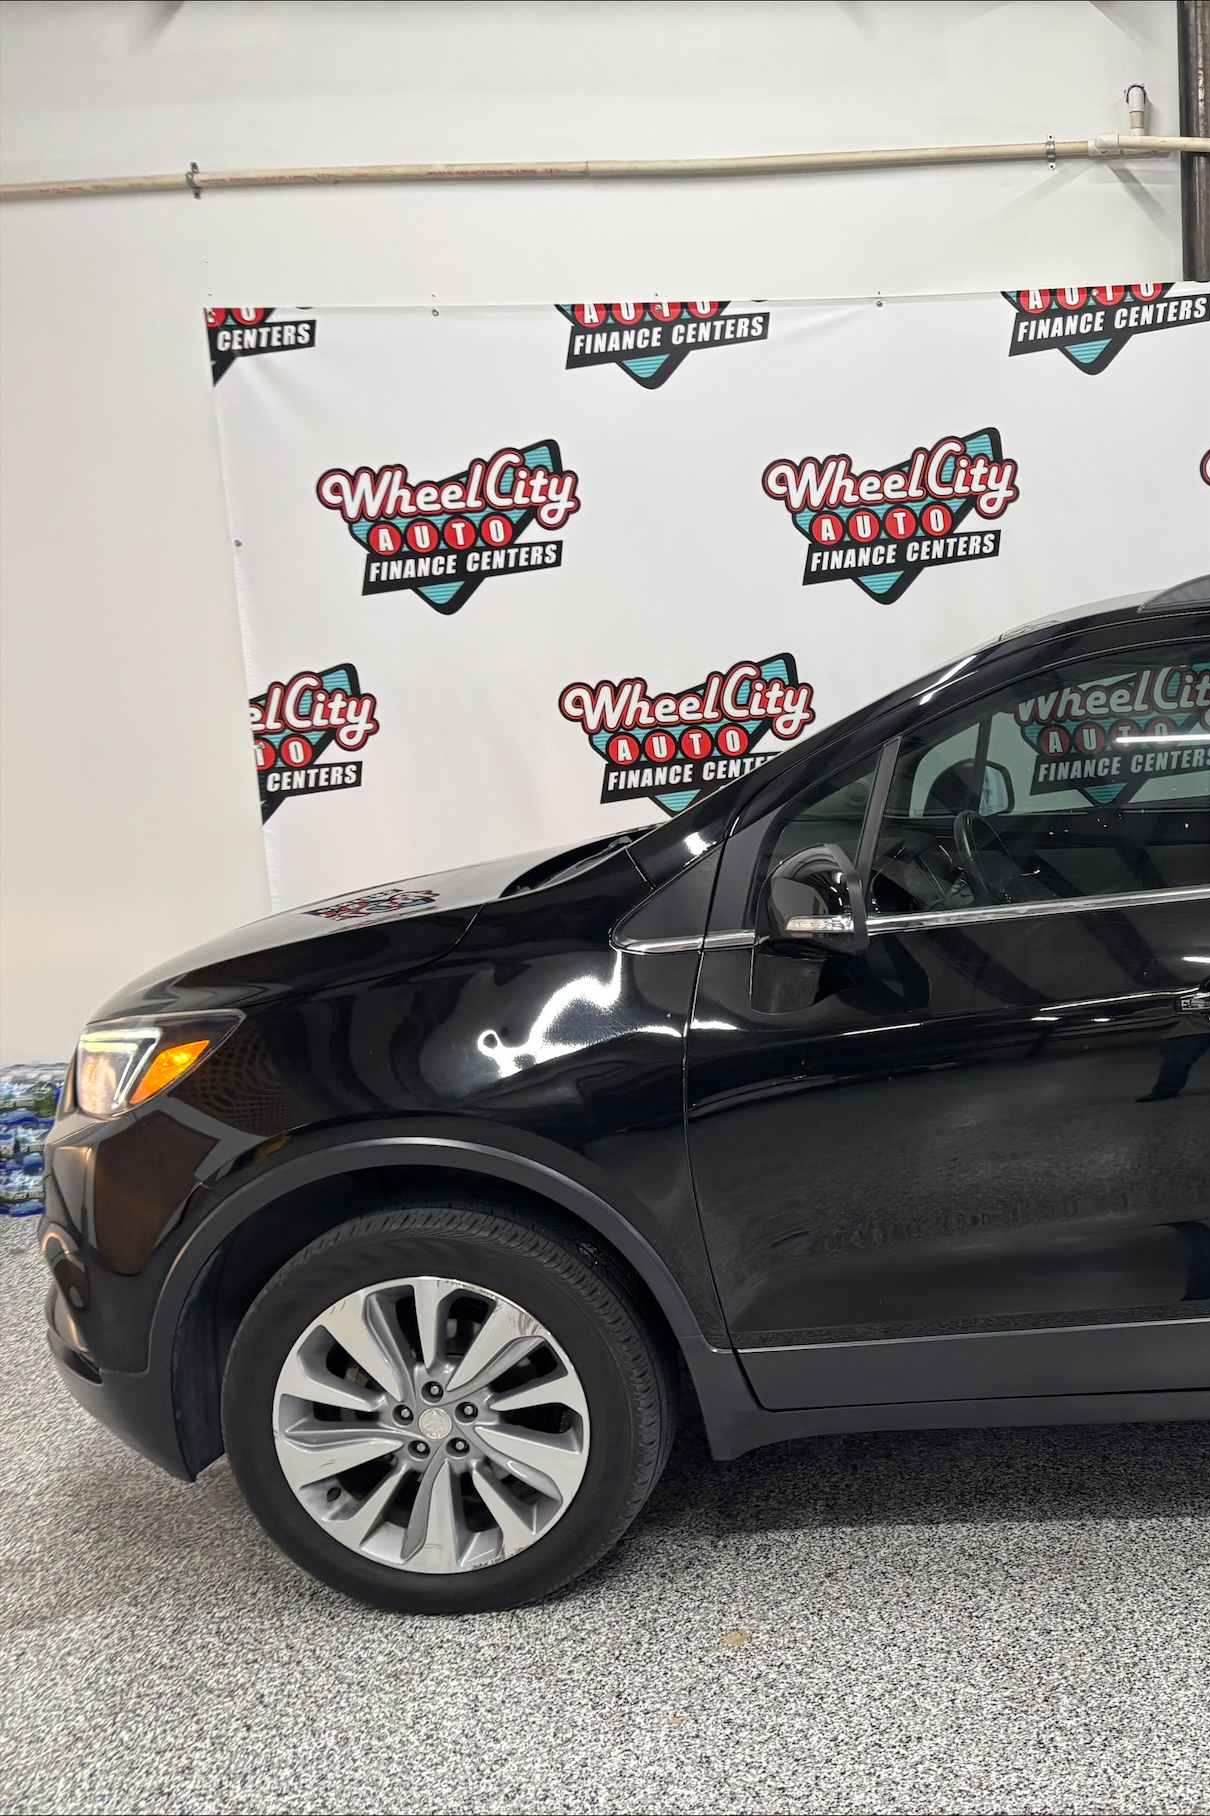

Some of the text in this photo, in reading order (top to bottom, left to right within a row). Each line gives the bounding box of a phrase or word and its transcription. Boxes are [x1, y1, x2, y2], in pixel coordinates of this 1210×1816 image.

[573, 316, 765, 356] FINANCE CENTERS
[1017, 297, 1208, 343] FINANCE CENTERS
[216, 323, 311, 352] CENTERS
[378, 519, 506, 552] AUTO
[821, 508, 945, 542] AUTO
[369, 543, 557, 583] FINANCE CENTERS
[810, 533, 995, 572] FINANCE CENTERS
[617, 730, 741, 762] AUTO
[1048, 722, 1169, 753] AUTO
[266, 764, 358, 792] CENTERS
[607, 756, 775, 792] FINANCE CENT
[1038, 756, 1122, 783] FINANCE
